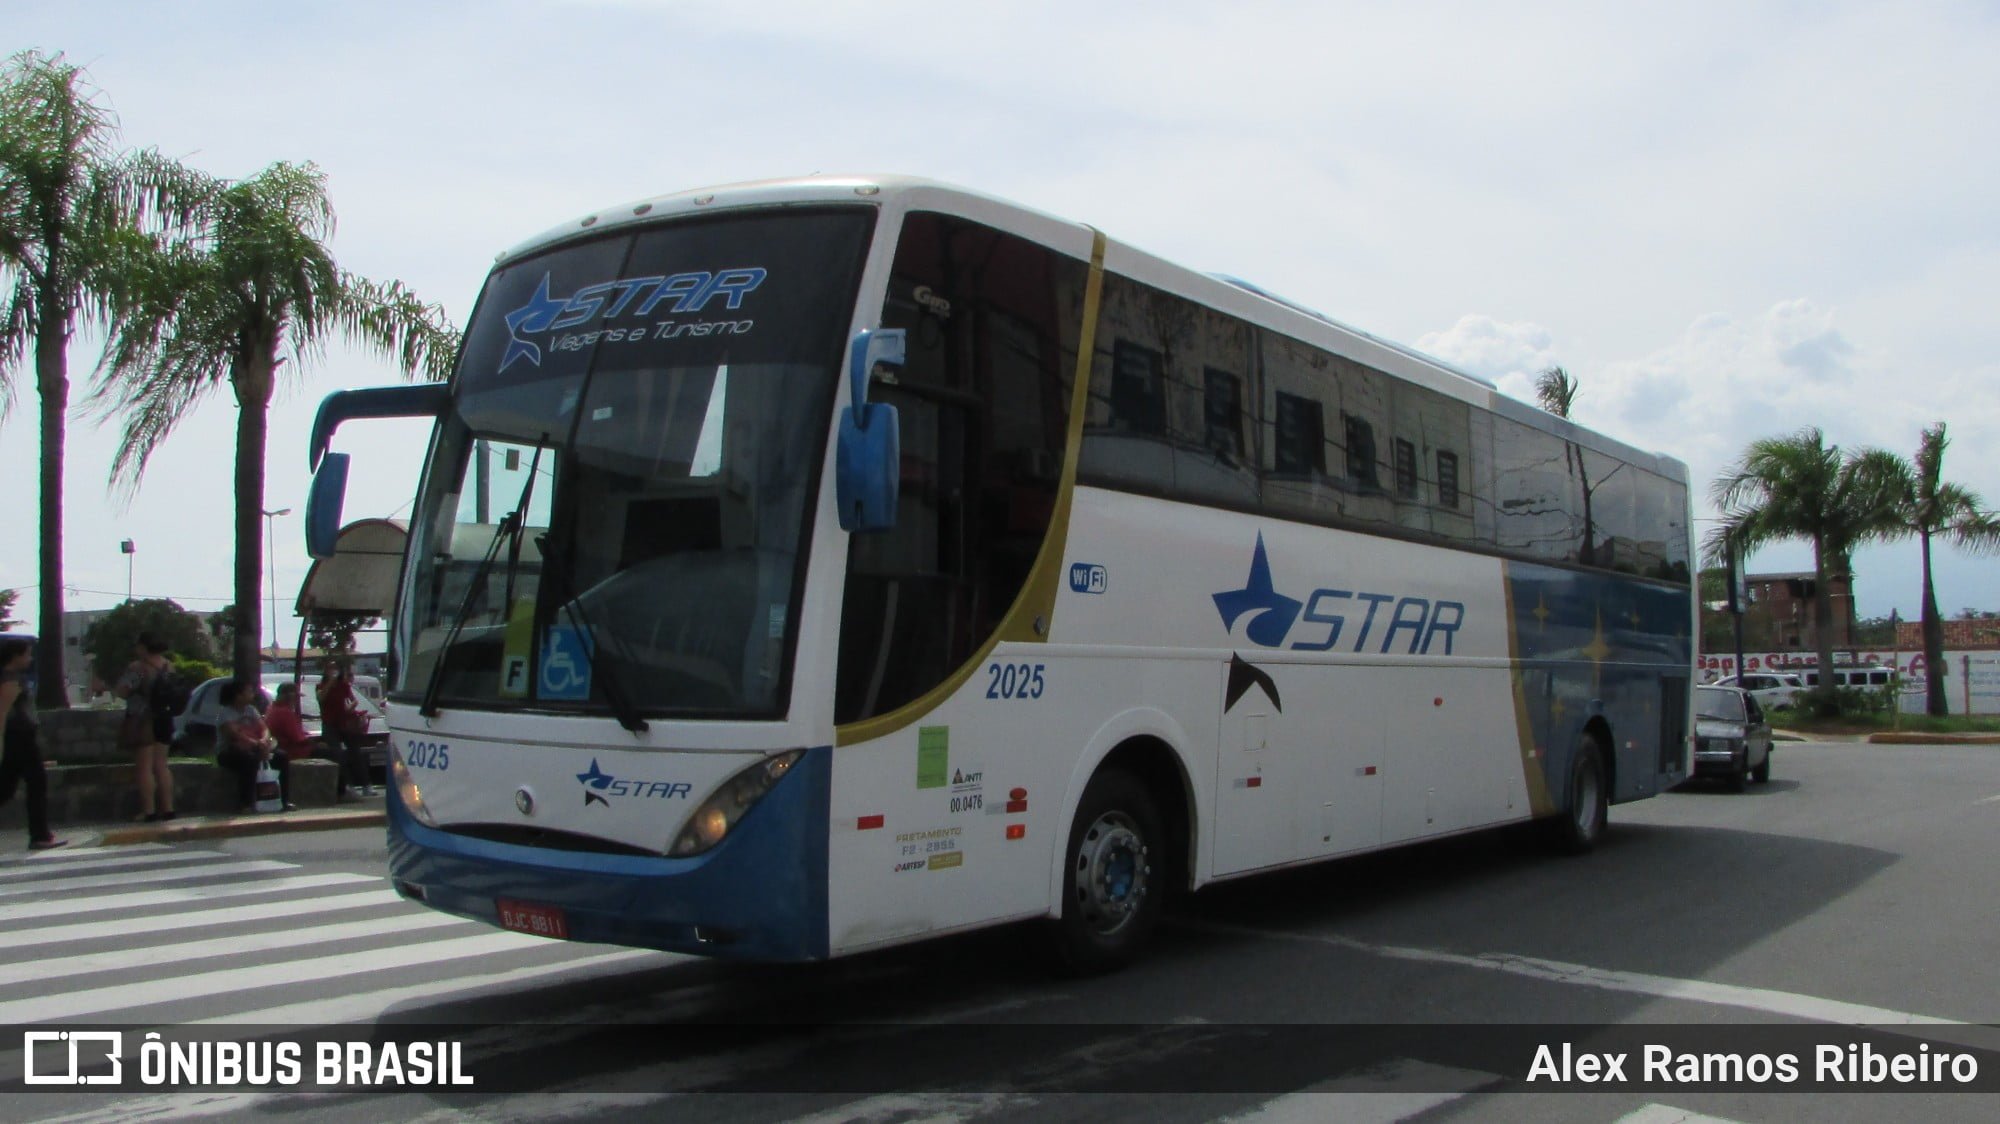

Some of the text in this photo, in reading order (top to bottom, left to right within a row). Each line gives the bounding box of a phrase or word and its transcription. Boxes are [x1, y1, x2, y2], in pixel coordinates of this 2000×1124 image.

[552, 267, 767, 330] STAR
[628, 327, 647, 342] e
[653, 318, 754, 340] Turismo
[1291, 588, 1465, 655] STAR
[506, 660, 524, 688] F
[986, 663, 1045, 699] 2025
[408, 740, 449, 771] 2025
[609, 780, 692, 799] STAR
[950, 794, 983, 813] 00.0476
[896, 827, 962, 842] FRETAMENTO
